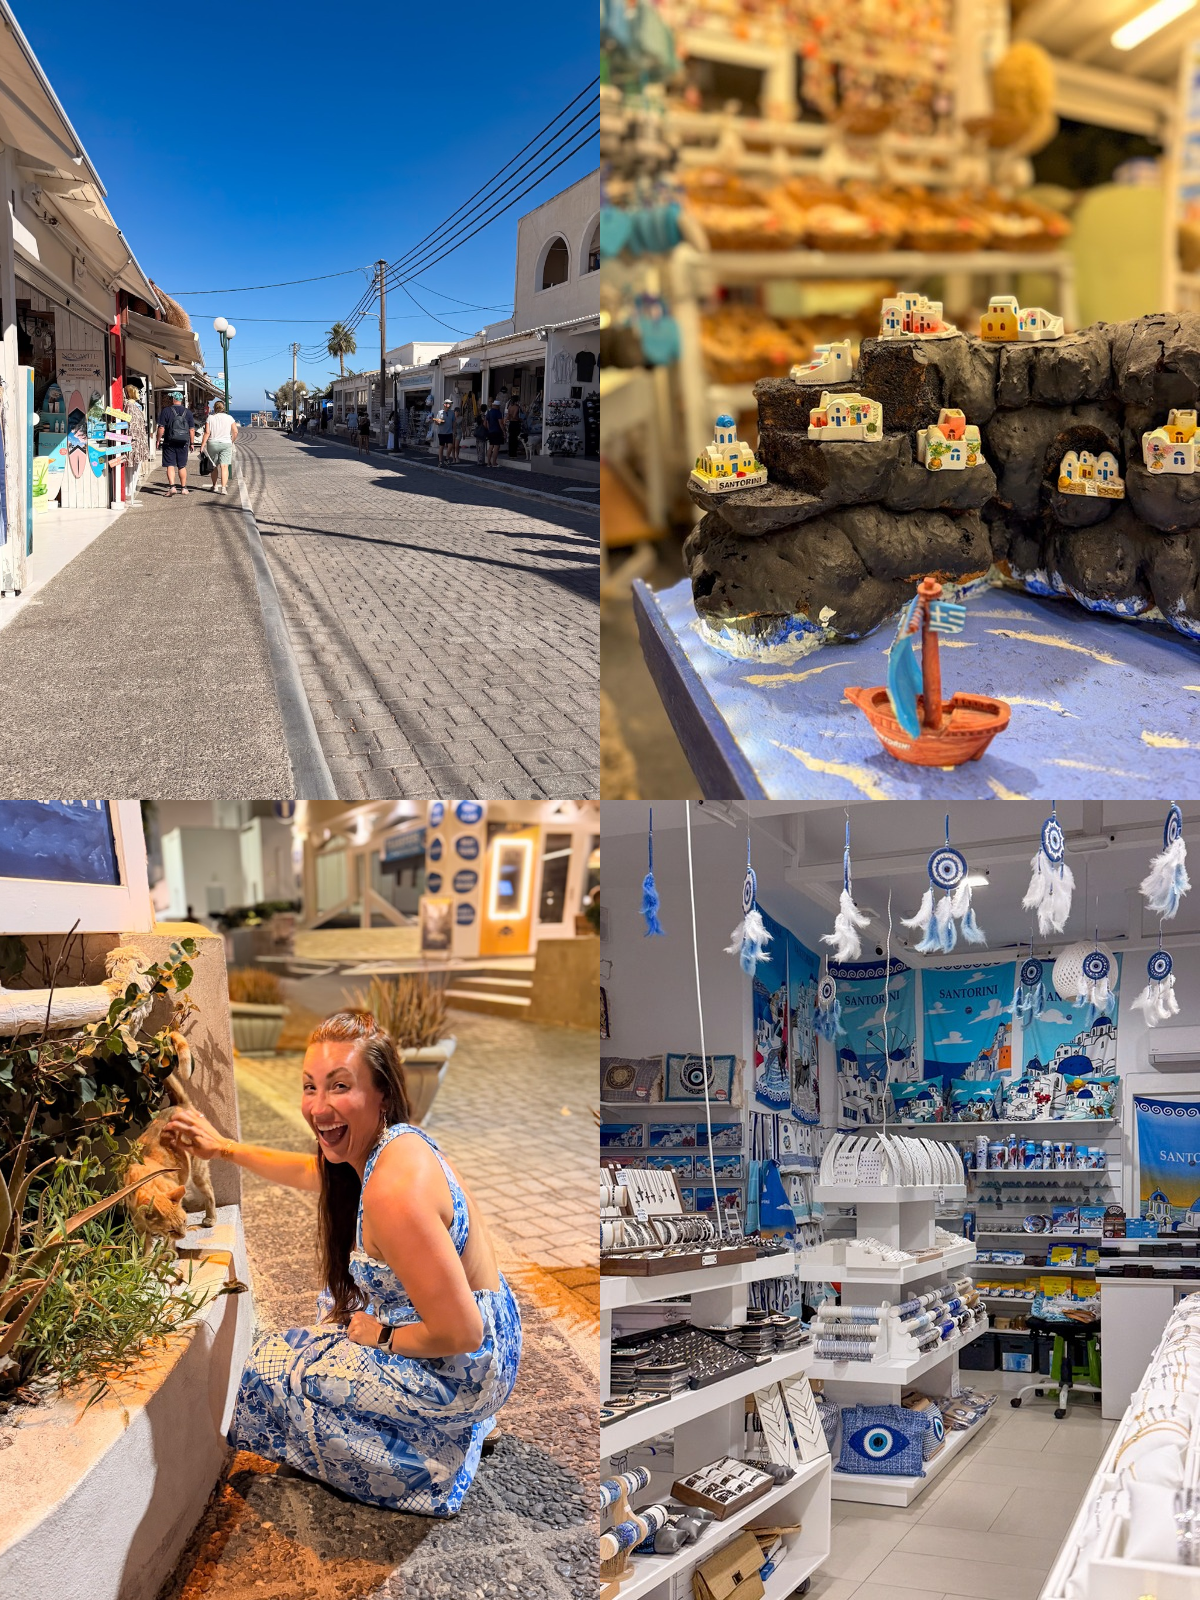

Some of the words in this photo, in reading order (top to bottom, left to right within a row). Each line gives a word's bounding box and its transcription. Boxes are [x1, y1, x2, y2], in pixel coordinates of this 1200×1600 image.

[719, 476, 762, 490] SANTORINI
[844, 990, 900, 1006] SANTORNI
[939, 984, 998, 999] SANTORINI
